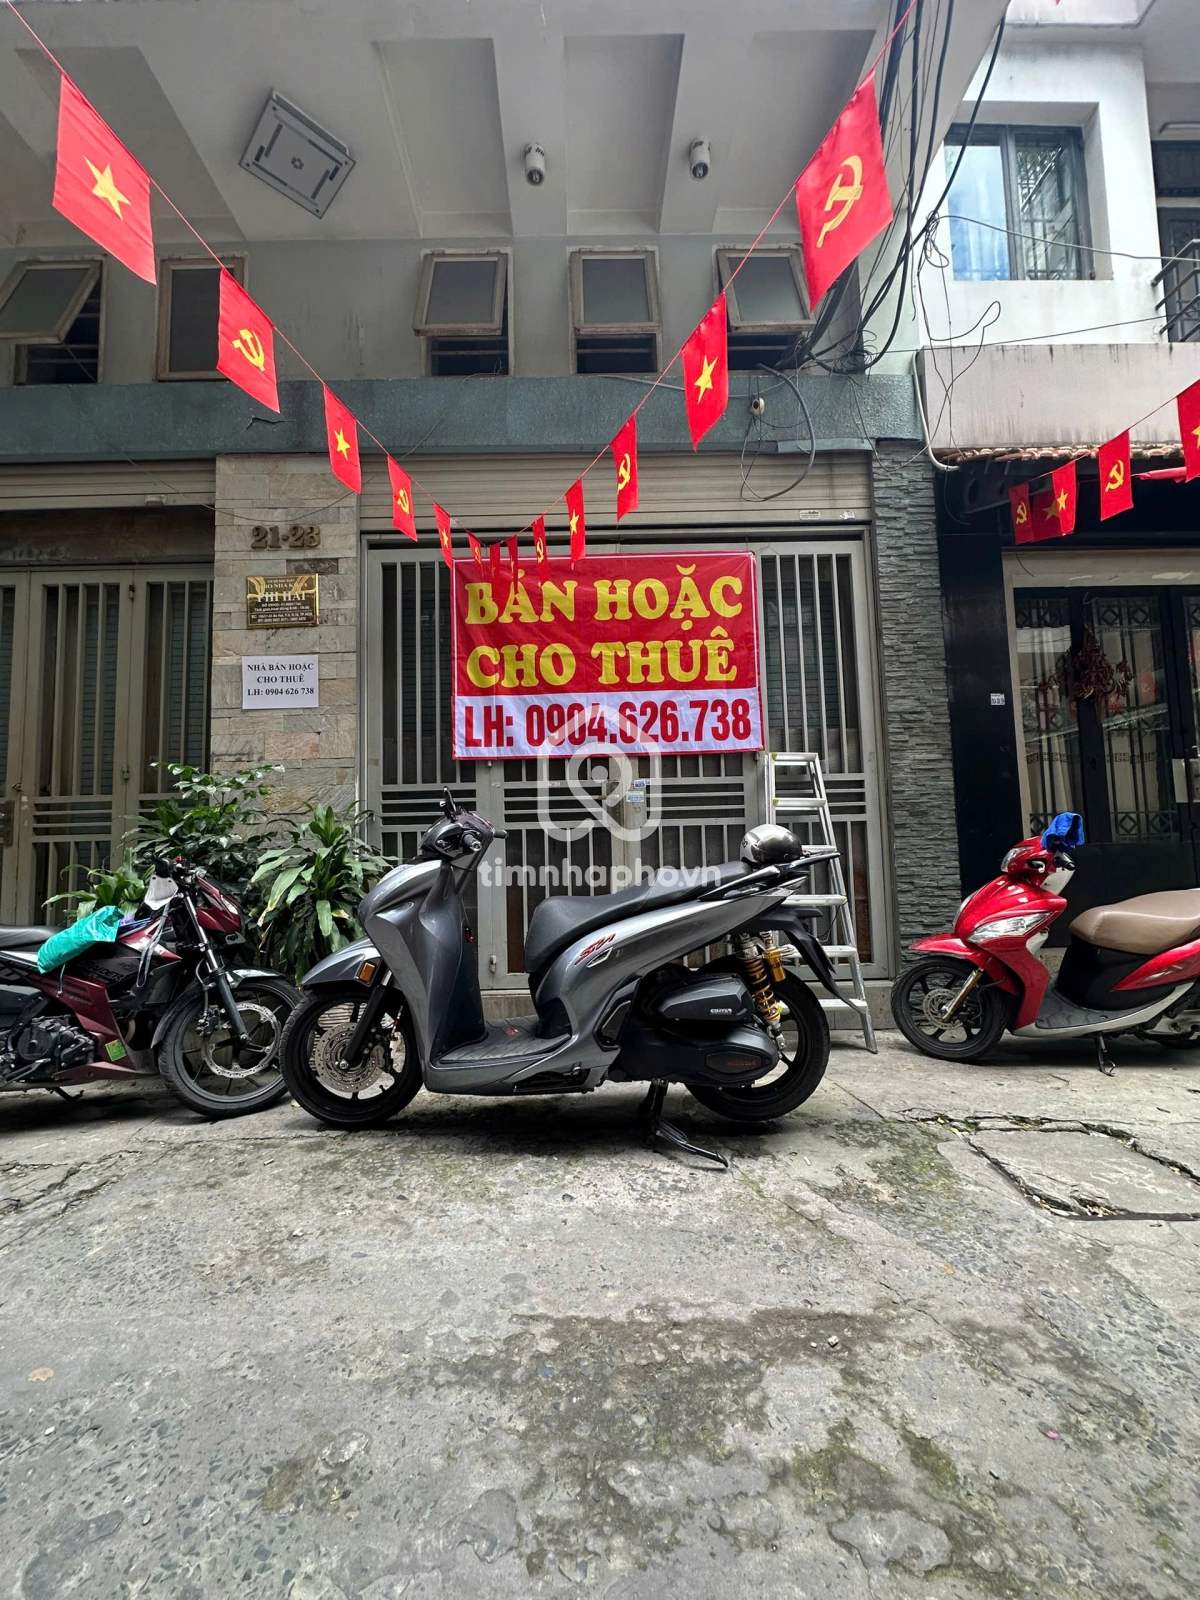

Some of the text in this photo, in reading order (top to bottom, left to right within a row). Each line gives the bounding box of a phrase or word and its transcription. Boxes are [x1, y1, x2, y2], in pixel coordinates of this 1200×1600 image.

[251, 525, 321, 549] 21-23
[593, 563, 743, 631] HOẶC
[247, 662, 266, 671] NHÀ
[268, 662, 287, 671] BÁN
[466, 625, 737, 688] CHO THUÊ
[256, 673, 305, 684] CHO THUÊ
[247, 687, 315, 696] LH: 0904 626 738
[464, 697, 751, 748] LH: 0904.626.738
